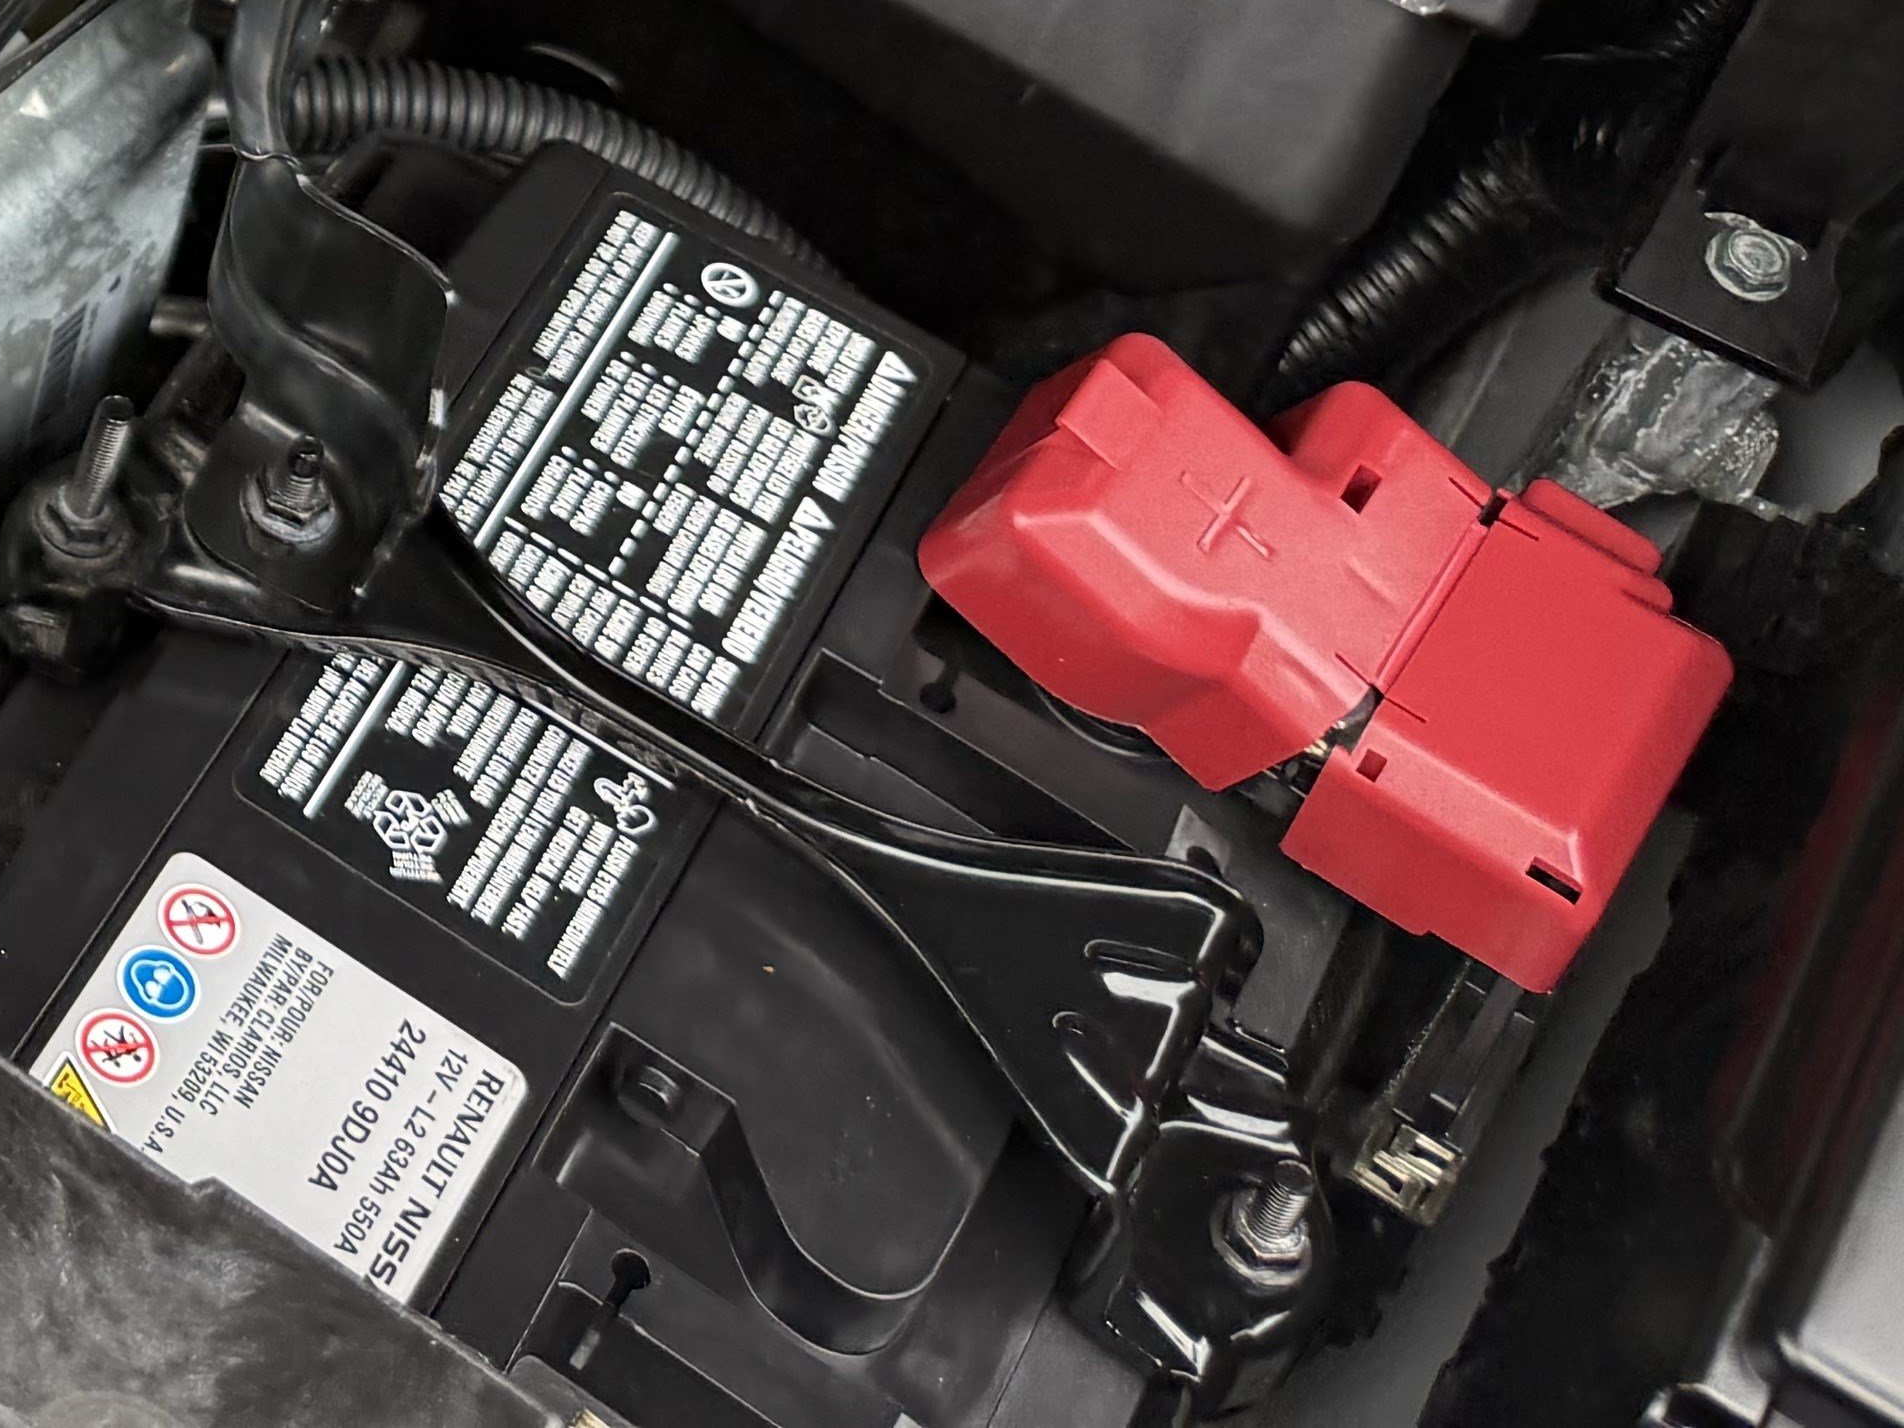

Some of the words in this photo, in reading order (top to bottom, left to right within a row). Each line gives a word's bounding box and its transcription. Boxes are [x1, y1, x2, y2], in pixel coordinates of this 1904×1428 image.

[627, 290, 676, 347] SMOKING
[653, 301, 697, 352] FLAMES
[674, 313, 719, 364] SPARKS
[604, 359, 632, 382] DE
[622, 370, 653, 400] LES
[498, 385, 526, 412] PAS
[644, 383, 674, 411] LES
[589, 392, 639, 455] FLAMMES
[811, 373, 906, 503] DANGER/POISON
[488, 449, 513, 472] LA
[442, 473, 470, 501] PAS
[520, 454, 573, 521] CIGARROS
[549, 466, 594, 521] FLAMAS
[569, 479, 615, 537] CHISPAS
[615, 480, 648, 510] NO
[721, 520, 823, 664] PELIGRO/VENENO
[351, 657, 381, 685] DEL
[621, 632, 661, 678] SEVER
[645, 628, 692, 689] BLINDNES
[323, 677, 368, 732] ALCANCE
[410, 672, 436, 694] EL
[667, 665, 702, 703] CAUS
[288, 716, 312, 740] LA
[313, 721, 340, 747] DE
[384, 686, 428, 736] MÉDICO.
[411, 699, 451, 748] RÁPIDO
[445, 701, 480, 739] AGUA.
[300, 736, 331, 768] LOS
[484, 753, 513, 783] LOS
[469, 773, 501, 808] OJOS
[546, 768, 574, 796] LES
[562, 805, 592, 836] GET
[581, 820, 615, 858] WITH
[534, 826, 579, 881] MEDICAL
[558, 849, 599, 896] WATER.
[601, 834, 640, 879] FLUSH
[520, 873, 552, 912] HELP
[586, 869, 620, 907] EYES
[500, 901, 536, 941] FAST.
[219, 933, 294, 1028] MILWAUKEE,
[263, 946, 314, 1010] BY/PAR:
[270, 960, 335, 1047] FOR/POUR:
[207, 1029, 234, 1056] WI
[216, 1008, 276, 1080] CLARIOS,
[365, 1018, 427, 1102] 24410
[171, 1051, 219, 1103] 53209,
[233, 1044, 283, 1110] NISSAN
[434, 1048, 469, 1093] 12V
[198, 1080, 231, 1117] LLC
[140, 1105, 186, 1154] U.S.A.
[403, 1105, 436, 1139] L2
[420, 1068, 506, 1200] RENAULT
[307, 1100, 379, 1192] 9DJ0A
[369, 1137, 416, 1196] 63Ah
[333, 1196, 382, 1255] 550A
